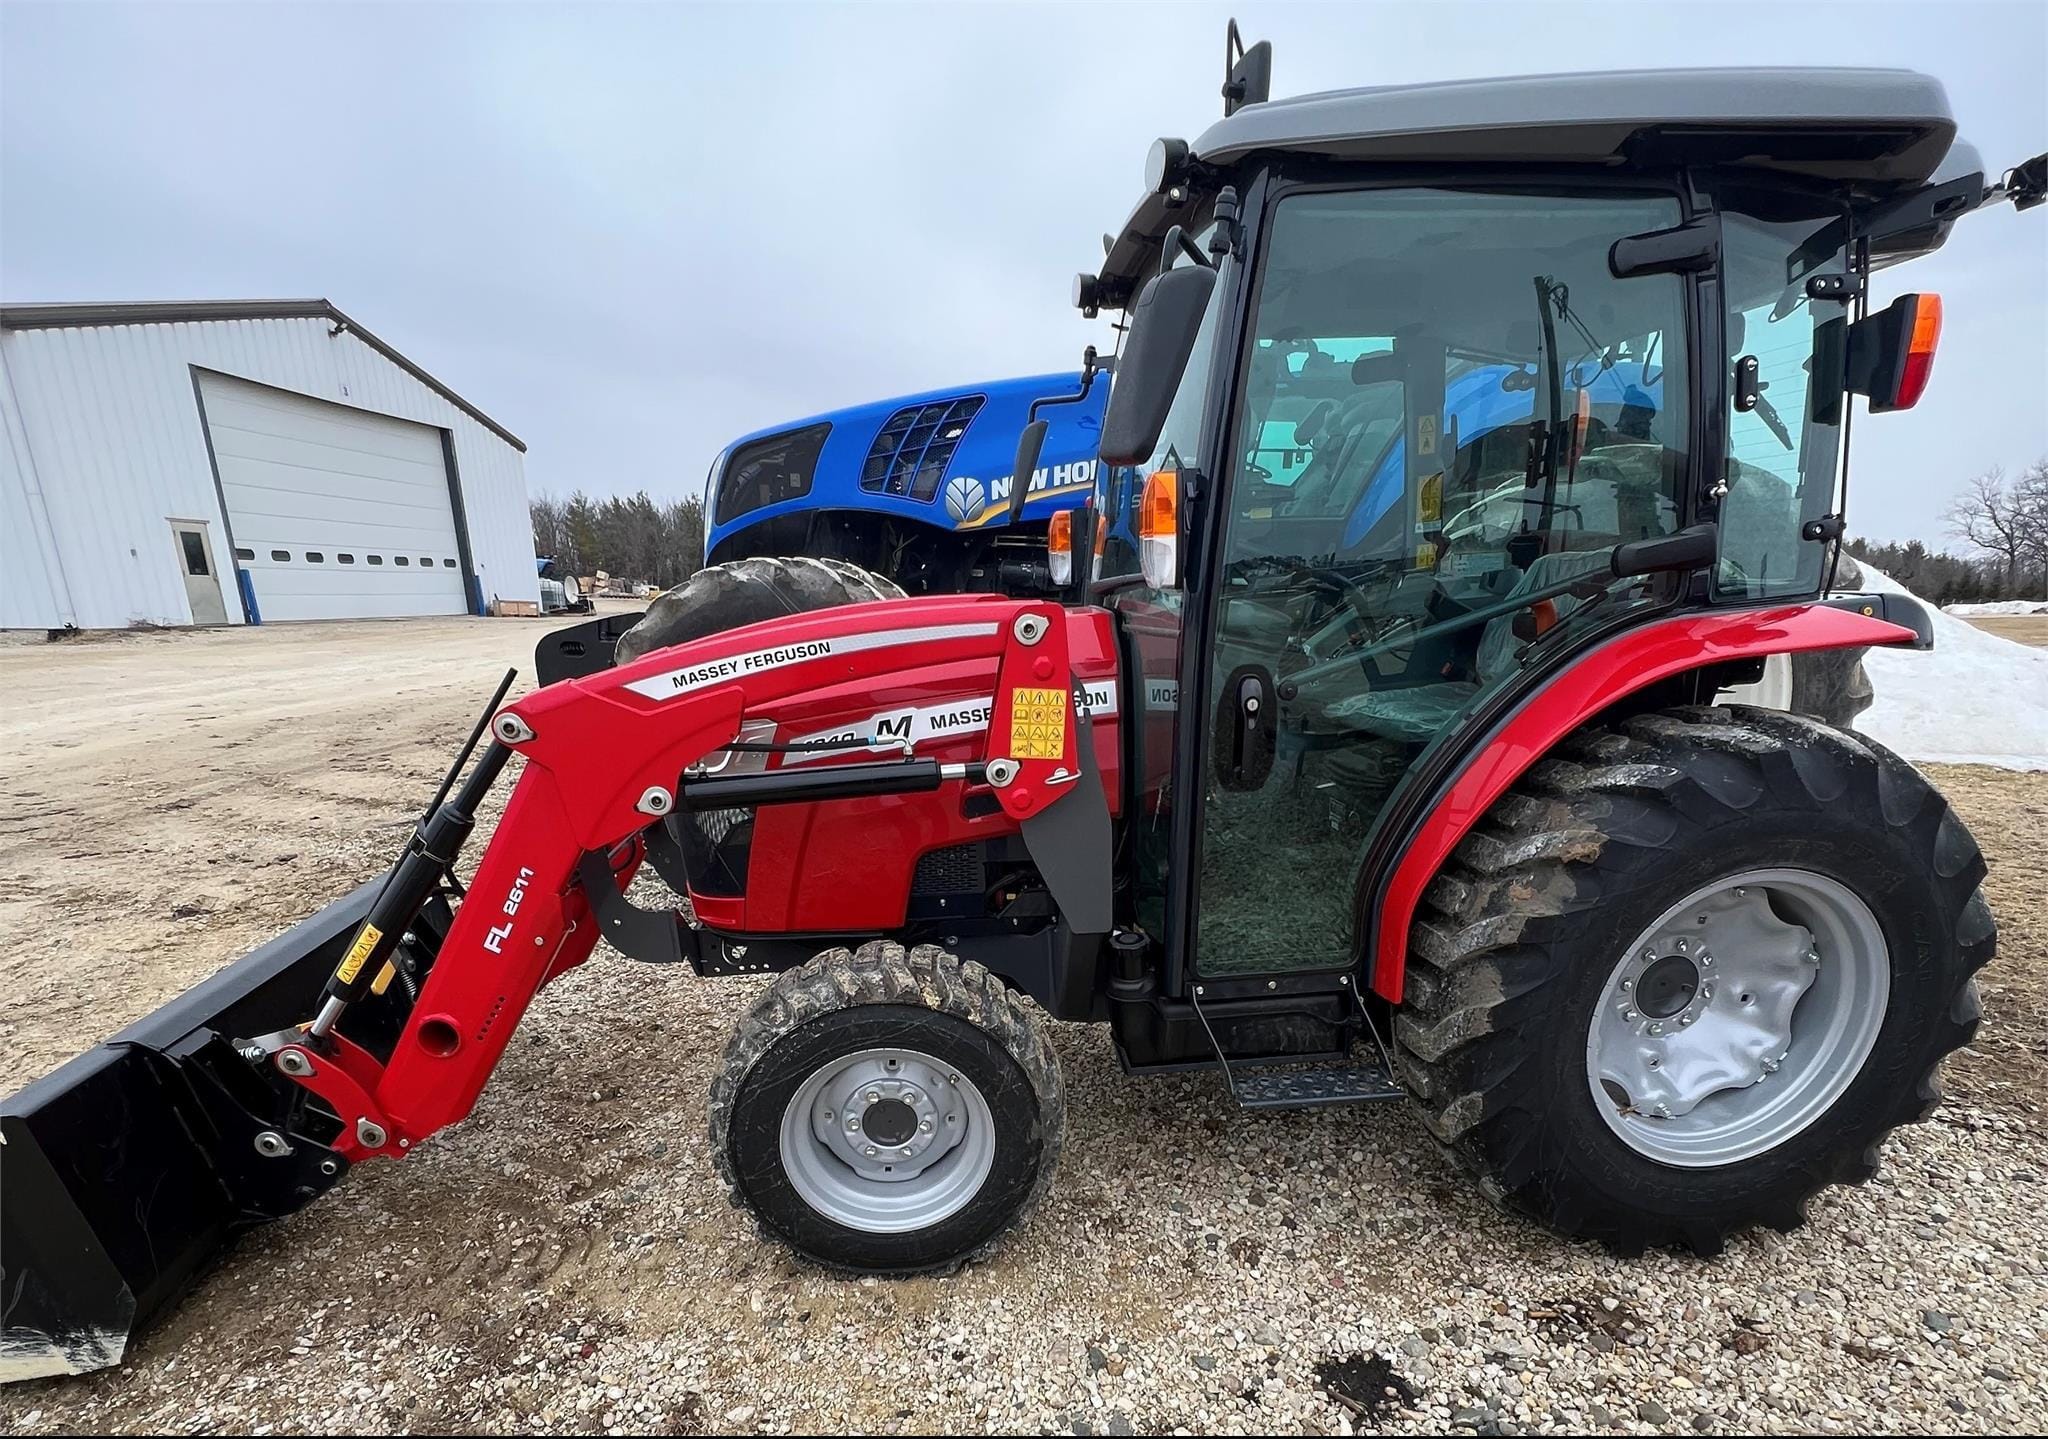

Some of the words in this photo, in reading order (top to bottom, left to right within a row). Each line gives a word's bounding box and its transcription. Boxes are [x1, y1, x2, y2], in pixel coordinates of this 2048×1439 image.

[991, 468, 1048, 500] NW
[672, 660, 738, 688] MASSEY
[744, 641, 831, 669] FERGUSON
[877, 715, 913, 739] M
[483, 922, 514, 954] FL
[502, 866, 535, 916] 2611
